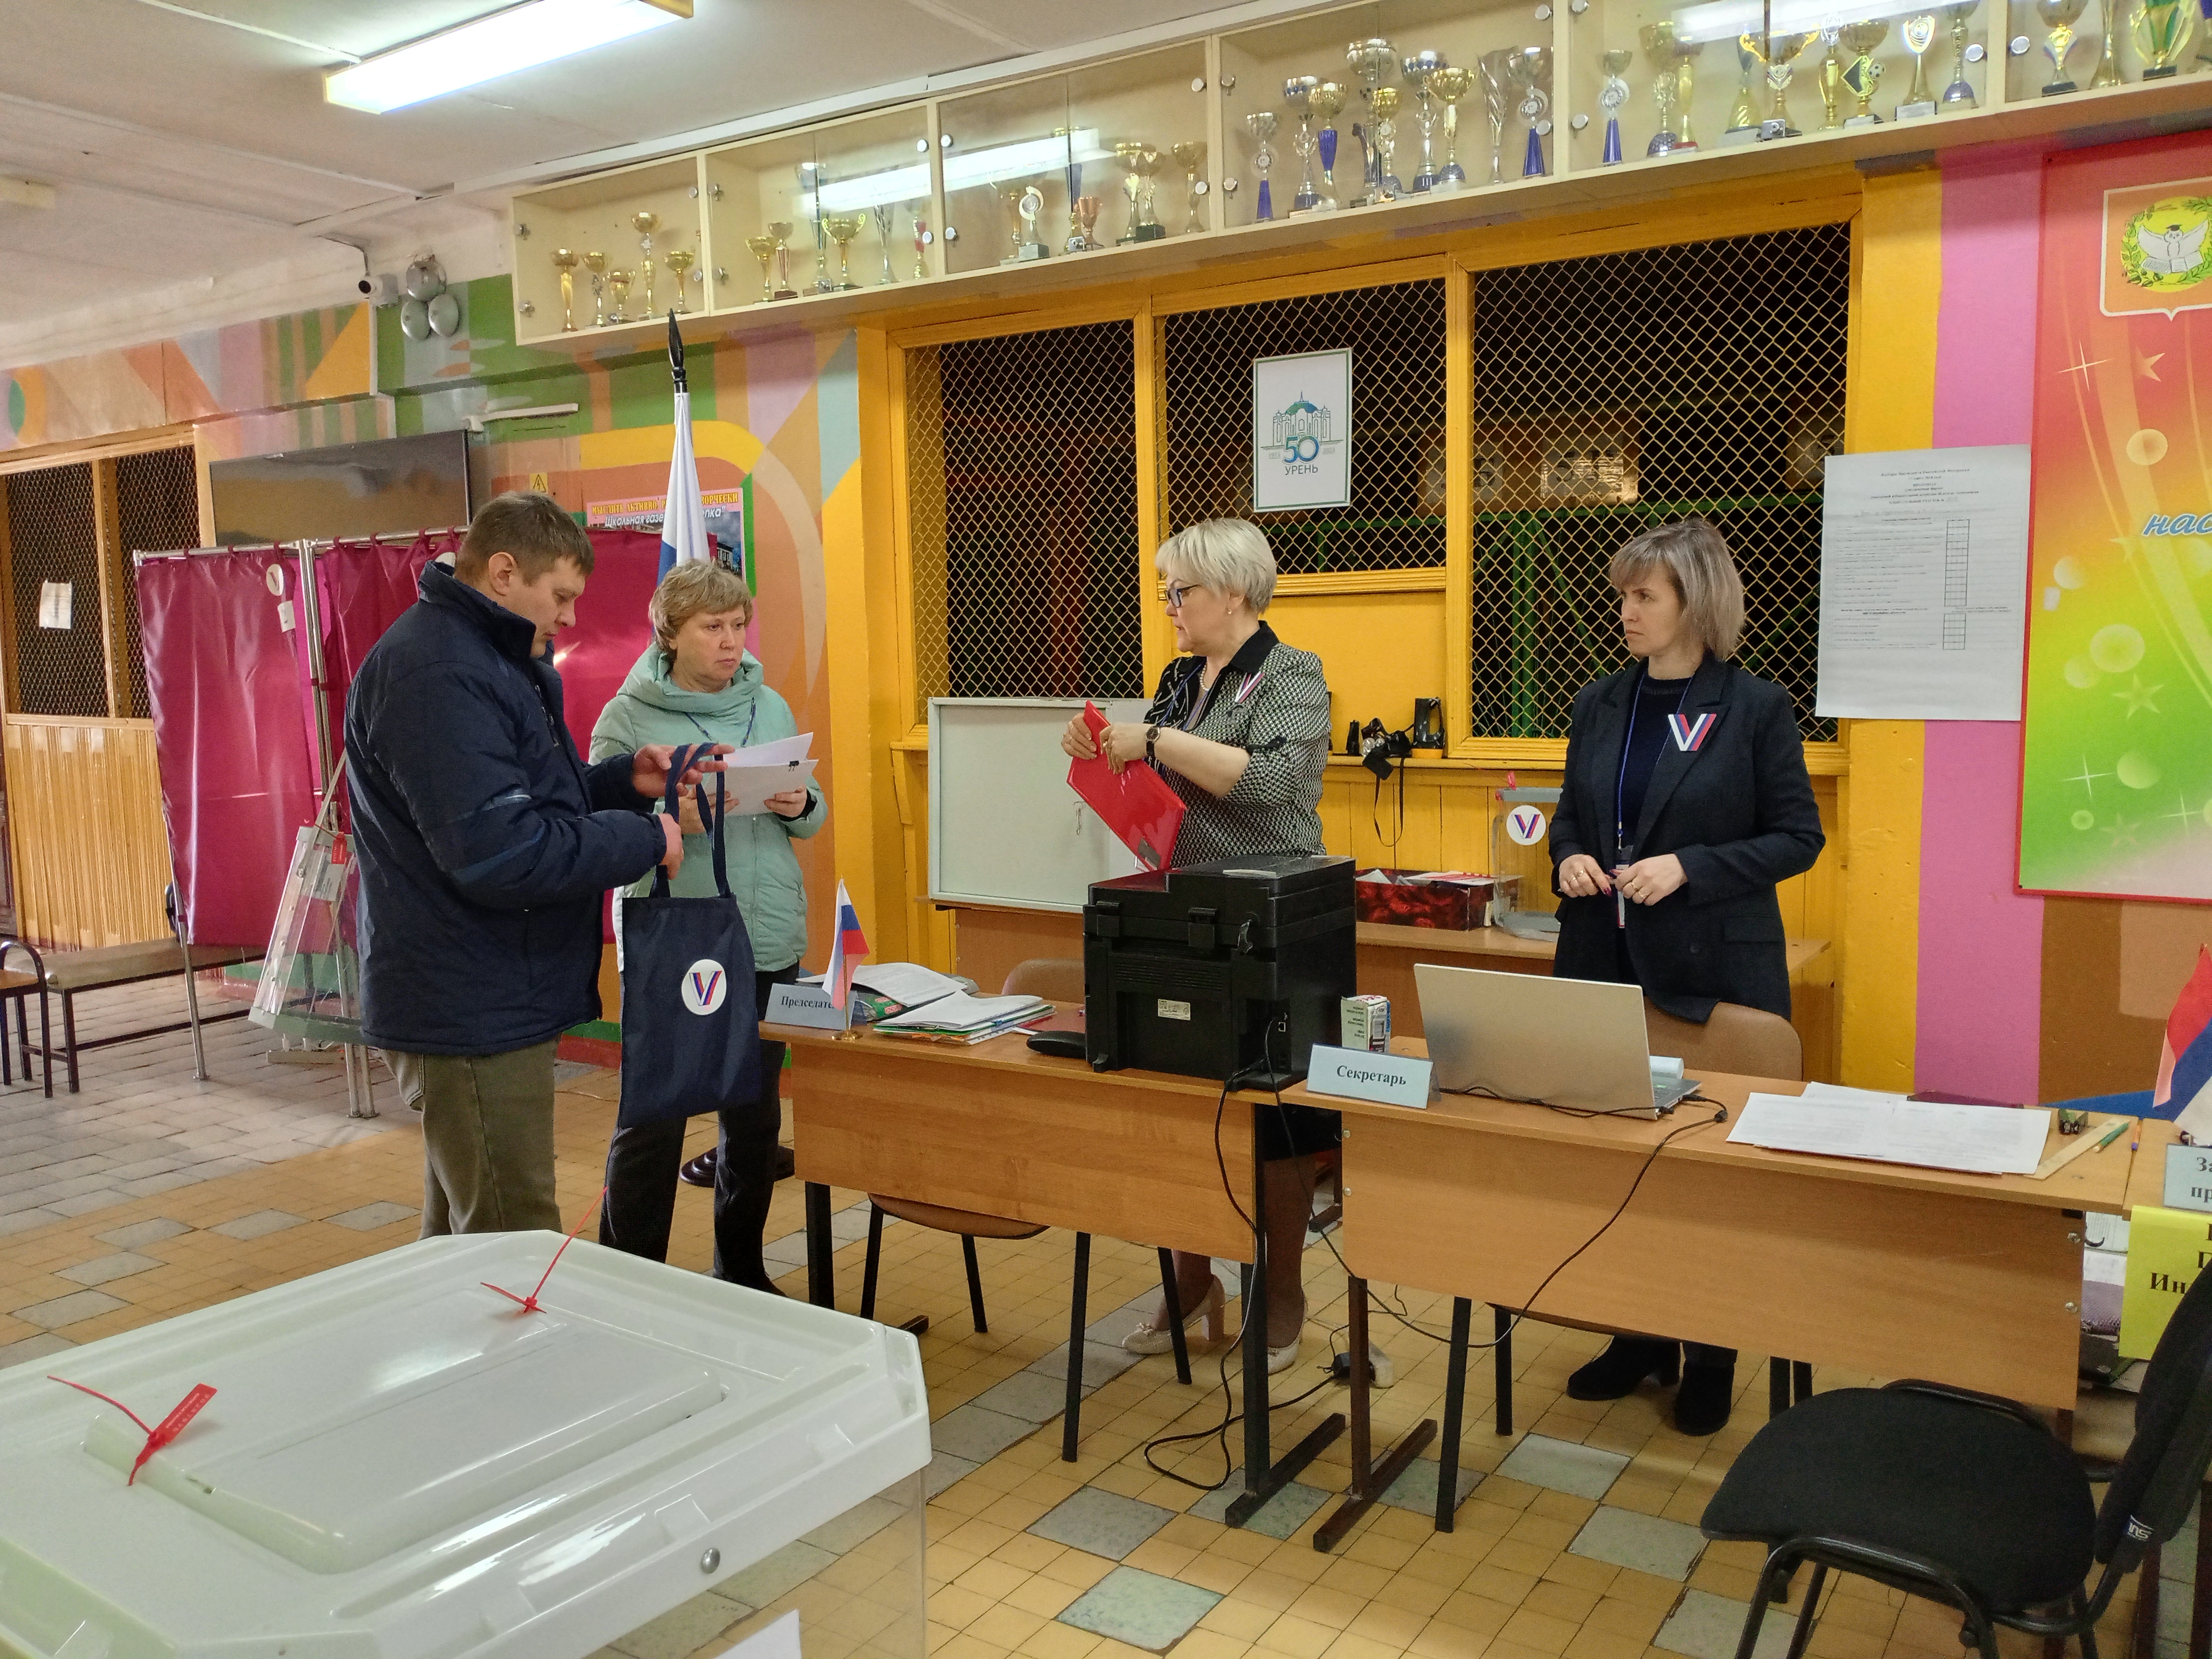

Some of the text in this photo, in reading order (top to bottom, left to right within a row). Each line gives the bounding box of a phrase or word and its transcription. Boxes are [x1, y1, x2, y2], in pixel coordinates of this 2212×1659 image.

[1283, 434, 1320, 464] 50
[1285, 464, 1319, 475] УРЕНЬ
[701, 492, 739, 505] ВОРЧЕСКИ
[604, 515, 644, 528] Школьная
[646, 513, 665, 524] газе
[781, 996, 835, 1009] Председате
[1336, 1065, 1407, 1087] Секретарь
